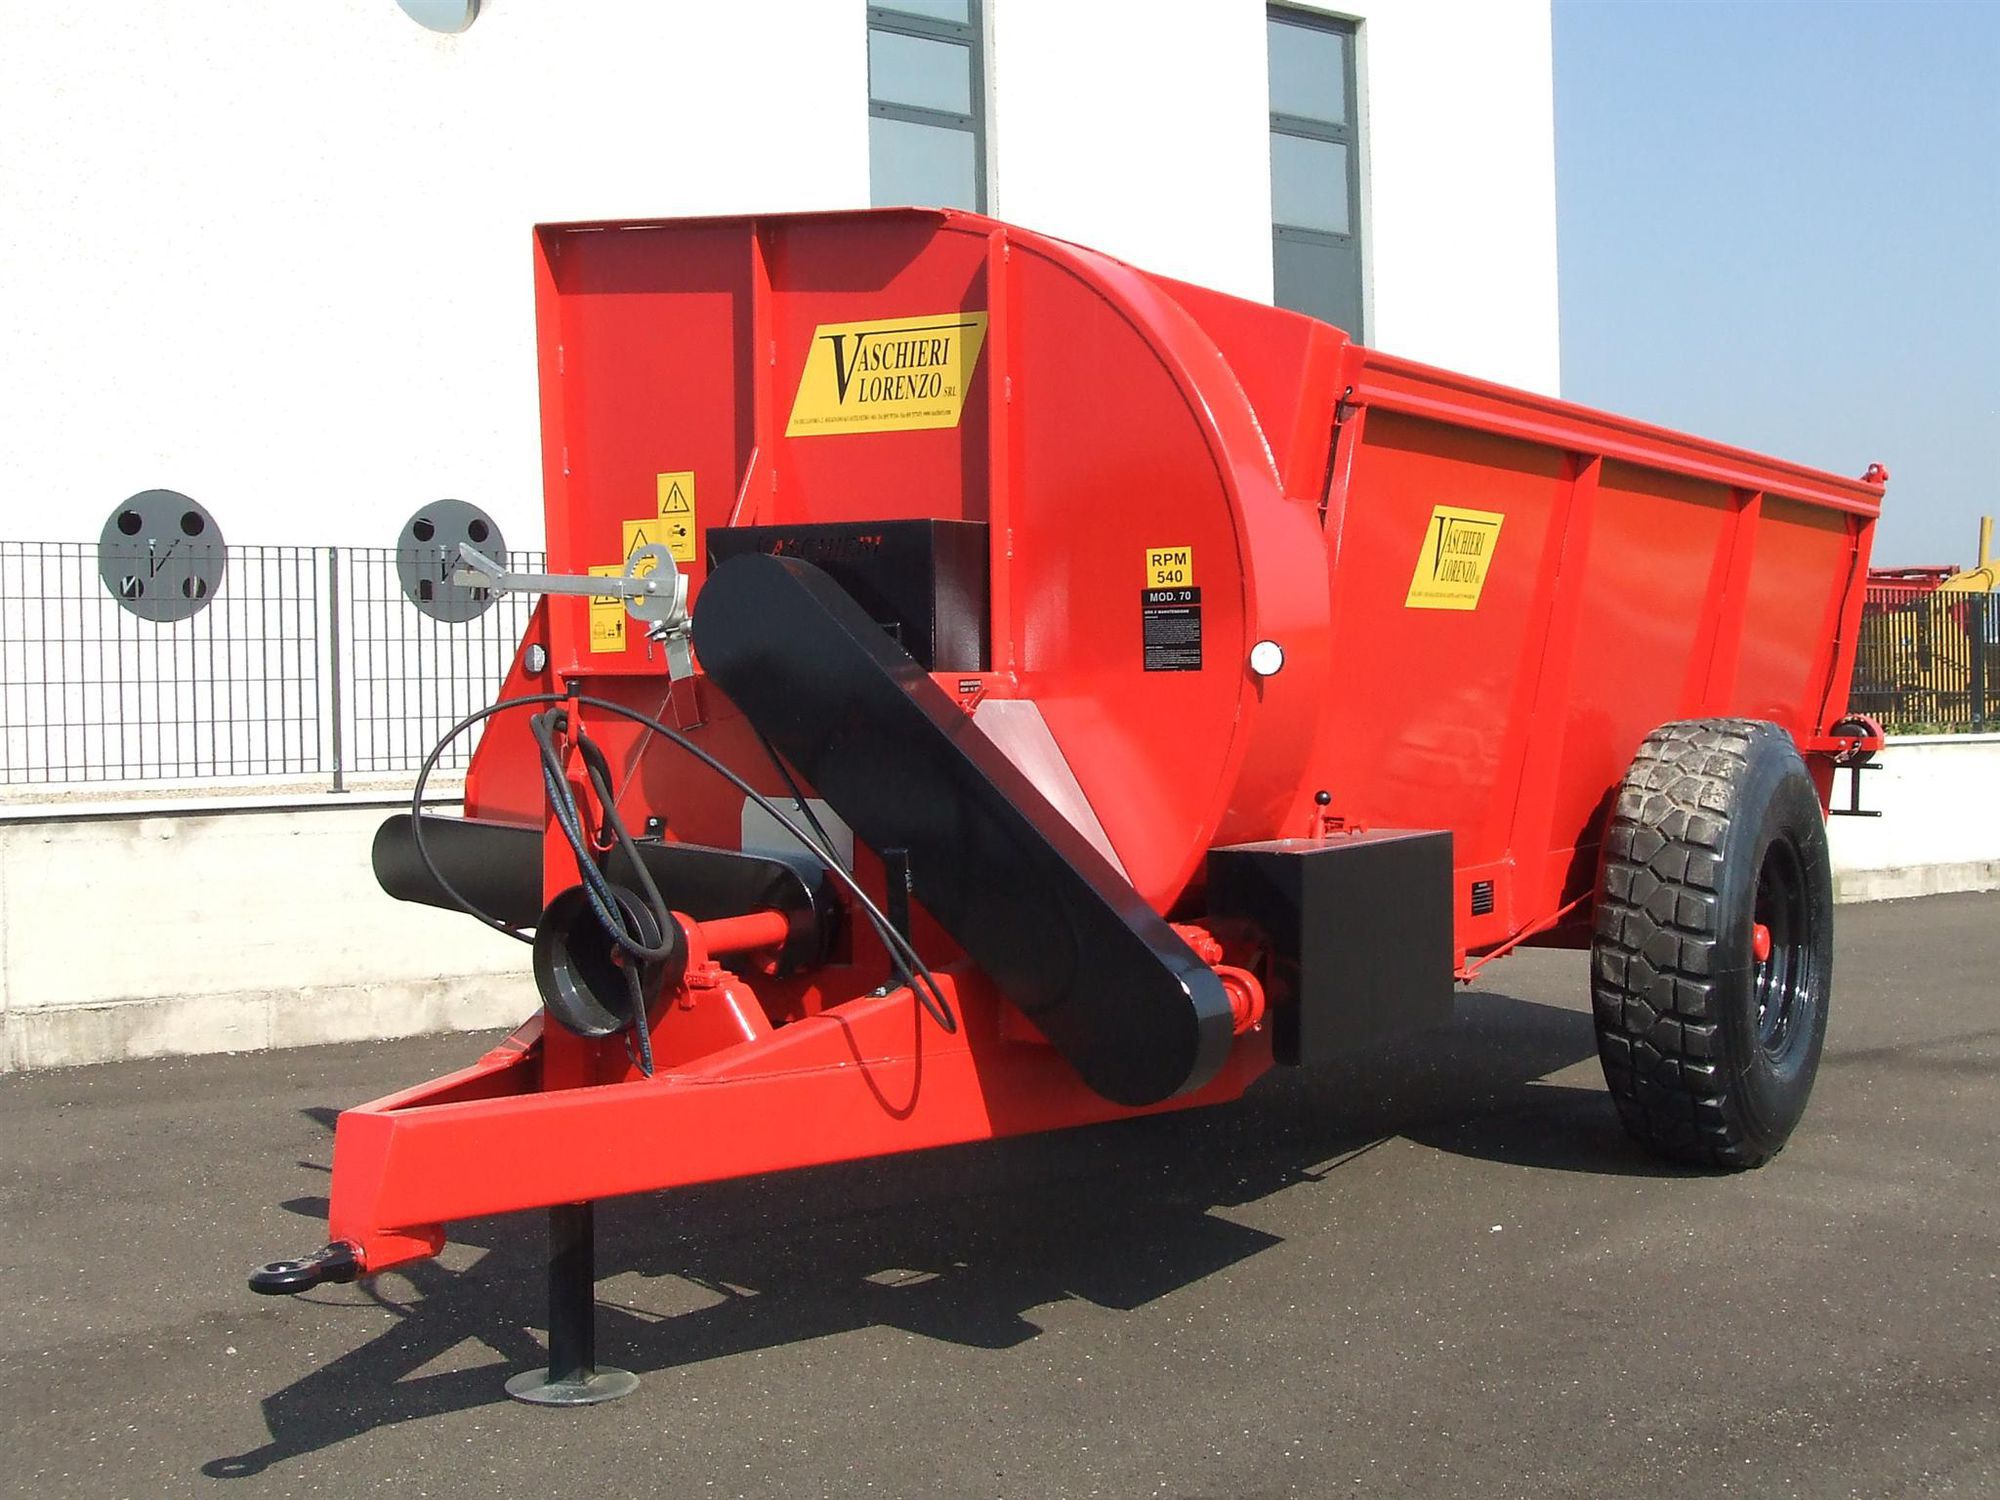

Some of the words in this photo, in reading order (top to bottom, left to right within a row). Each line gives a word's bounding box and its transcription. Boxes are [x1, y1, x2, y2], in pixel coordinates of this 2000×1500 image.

[820, 334, 950, 405] VASCHIERI
[858, 372, 942, 403] LORENZO
[943, 385, 957, 398] SRL
[1152, 553, 1187, 567] RPM
[1157, 570, 1183, 583] 540
[1440, 559, 1477, 583] LORENZO
[1149, 592, 1176, 602] MOD.
[1179, 591, 1192, 600] 70
